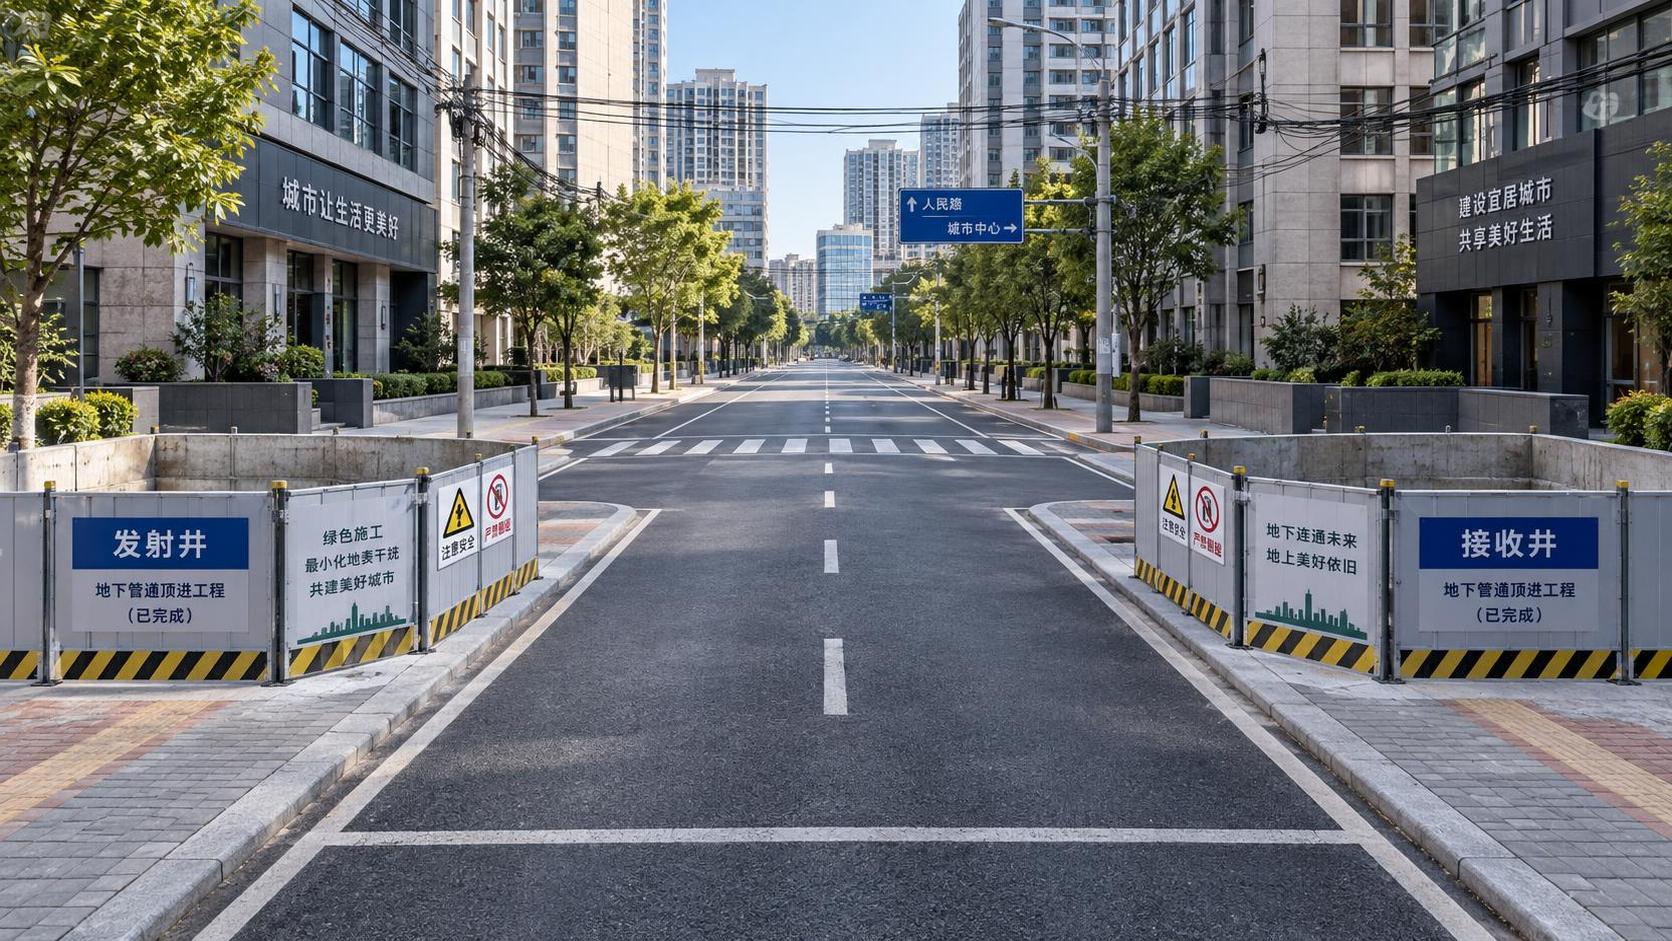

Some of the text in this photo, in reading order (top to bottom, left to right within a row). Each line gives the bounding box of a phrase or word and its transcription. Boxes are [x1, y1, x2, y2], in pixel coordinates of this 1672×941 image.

[282, 176, 399, 240] 城市让生活更美好
[1459, 176, 1552, 219] 建设宜居城市
[1459, 213, 1552, 253] 共享美好生活
[113, 529, 207, 559] 发射井
[322, 524, 383, 546] 绿色施工
[1266, 522, 1357, 549] 地下连通未来
[1461, 529, 1557, 559] 接收井
[1266, 547, 1357, 575] 地上美好依旧
[310, 570, 395, 598] 共建美好城市
[127, 607, 193, 625] （已完成）
[1476, 606, 1543, 624] （已完成）
